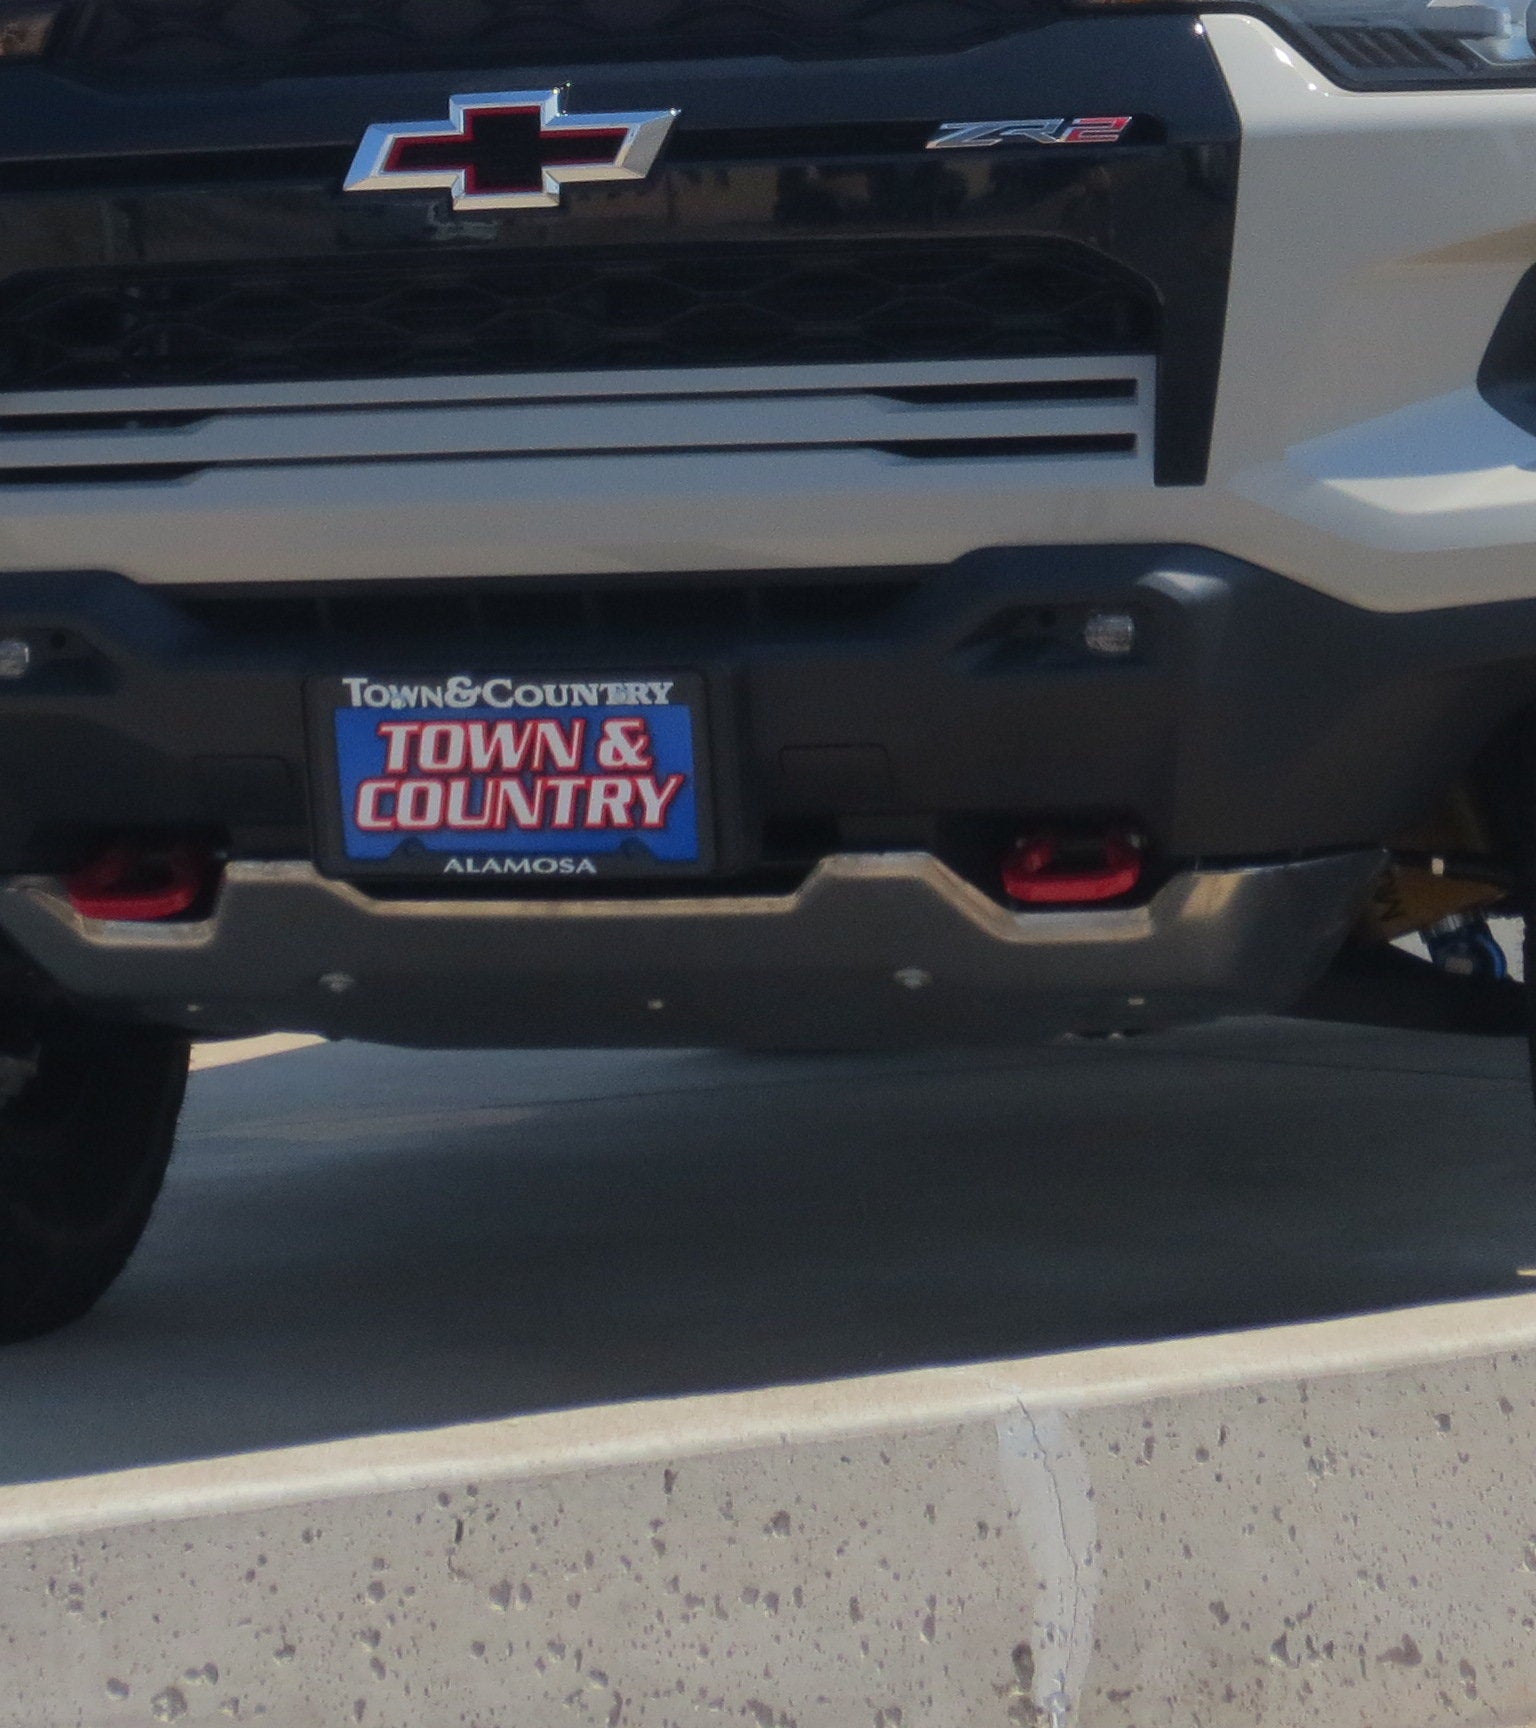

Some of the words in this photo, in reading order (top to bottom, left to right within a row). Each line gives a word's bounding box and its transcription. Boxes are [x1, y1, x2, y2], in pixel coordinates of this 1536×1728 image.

[924, 115, 1133, 149] ZR2
[377, 717, 587, 774] TOWN
[596, 716, 652, 772] &
[355, 773, 684, 832] COUNTRY
[443, 857, 598, 875] ALAMOSA
